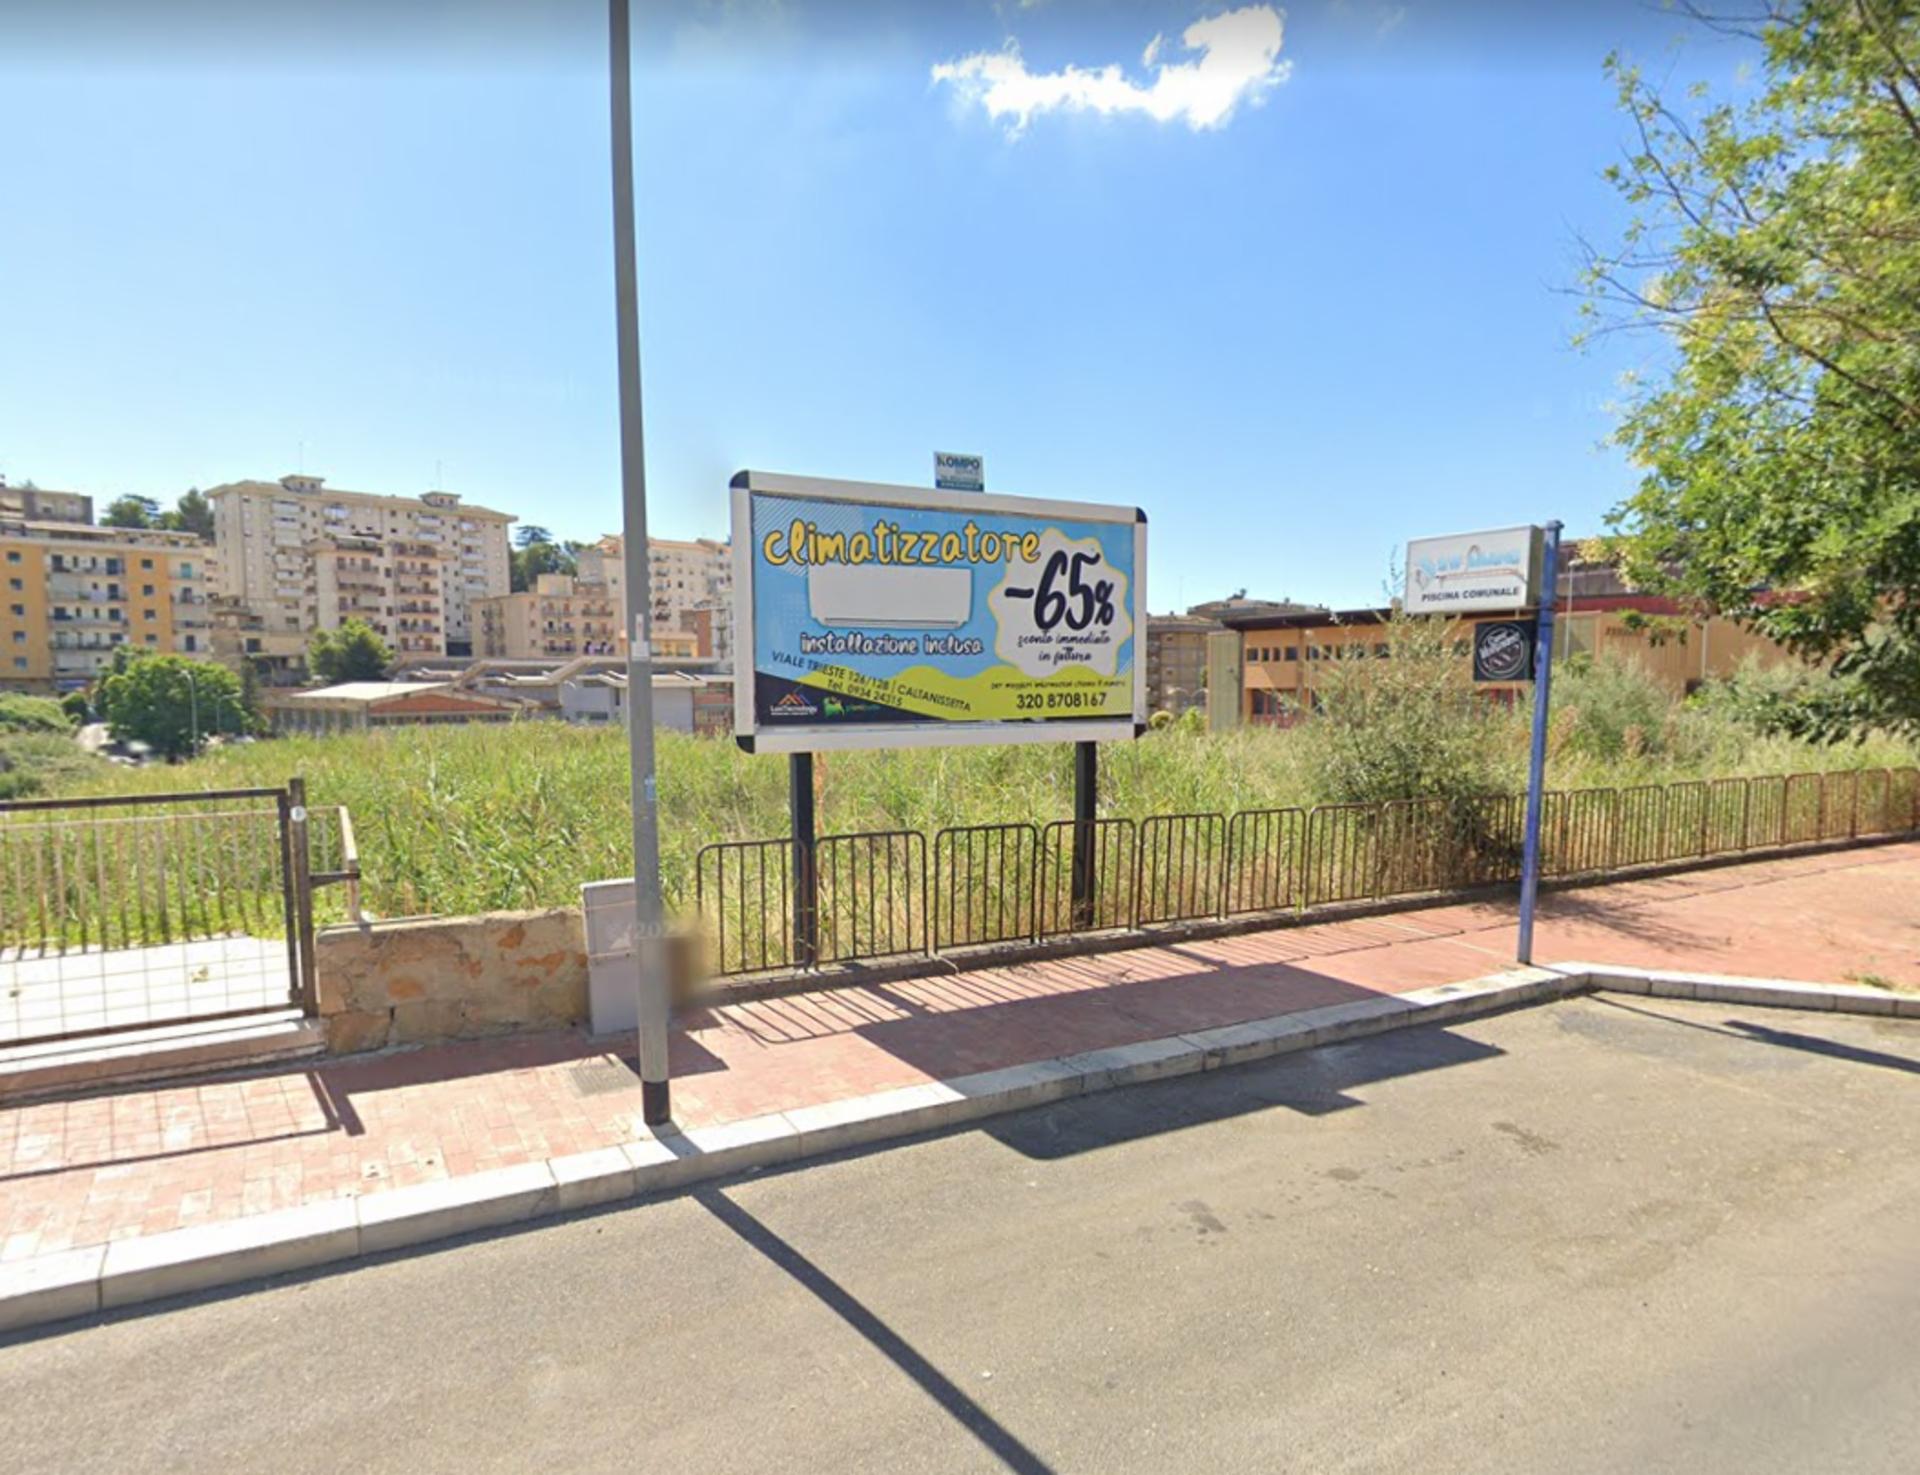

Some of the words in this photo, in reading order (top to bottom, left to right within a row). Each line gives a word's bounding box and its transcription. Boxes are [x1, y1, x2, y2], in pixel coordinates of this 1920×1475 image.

[763, 518, 1041, 566] climatizzatore
[1004, 550, 1114, 630] -65%
[1421, 591, 1459, 602] PISCINA
[1463, 587, 1519, 599] COMUNALE
[800, 632, 919, 656] installazione
[923, 634, 984, 656] inclusa
[1018, 630, 1053, 647] sconto
[1056, 630, 1111, 644] immediato
[1038, 651, 1051, 661] in
[1053, 647, 1092, 665] fattura
[771, 651, 804, 669] VIALE
[808, 659, 846, 680] TRIESTE
[849, 671, 889, 690] 126/128
[897, 684, 971, 712] CALTANISSETTA
[847, 684, 870, 699] 0934
[1016, 693, 1043, 709] 320
[1047, 692, 1107, 708] 8708167
